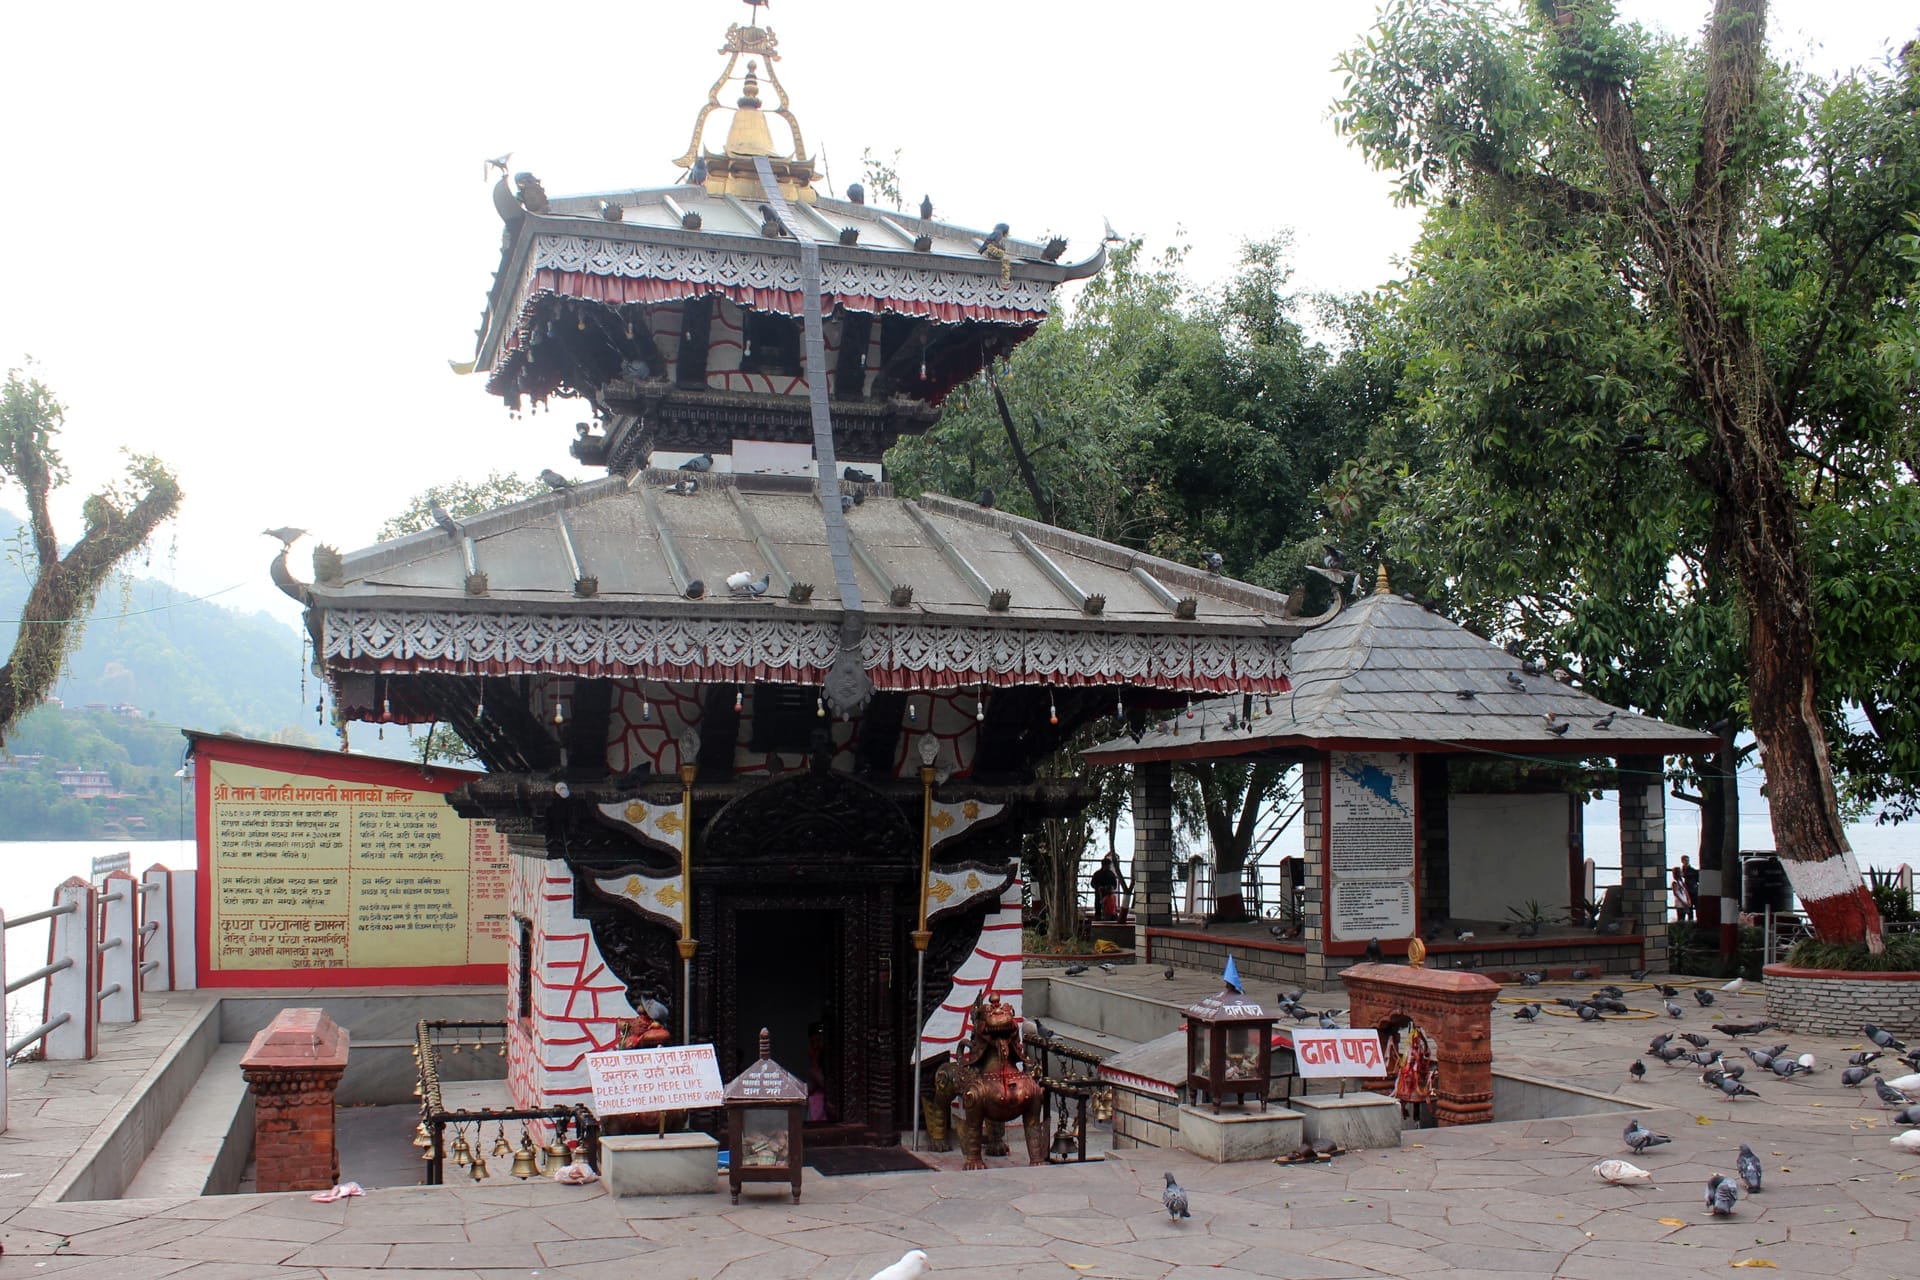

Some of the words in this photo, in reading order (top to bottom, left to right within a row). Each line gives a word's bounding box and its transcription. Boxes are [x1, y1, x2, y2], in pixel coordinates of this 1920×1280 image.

[214, 784, 228, 801] श्री
[232, 787, 256, 801] ताल
[296, 785, 337, 802] भगवती
[341, 785, 383, 802] माताको
[313, 920, 346, 931] चामल
[1243, 1005, 1263, 1016] पात्र
[1299, 1039, 1340, 1064] दान
[1341, 1038, 1381, 1069] पात्र
[597, 1083, 629, 1096] PLEASE
[633, 1082, 655, 1094] KEEP
[658, 1080, 681, 1091] HERE
[683, 1079, 703, 1089] LIKE
[649, 1094, 665, 1104] AND
[670, 1093, 701, 1103] LEATHER
